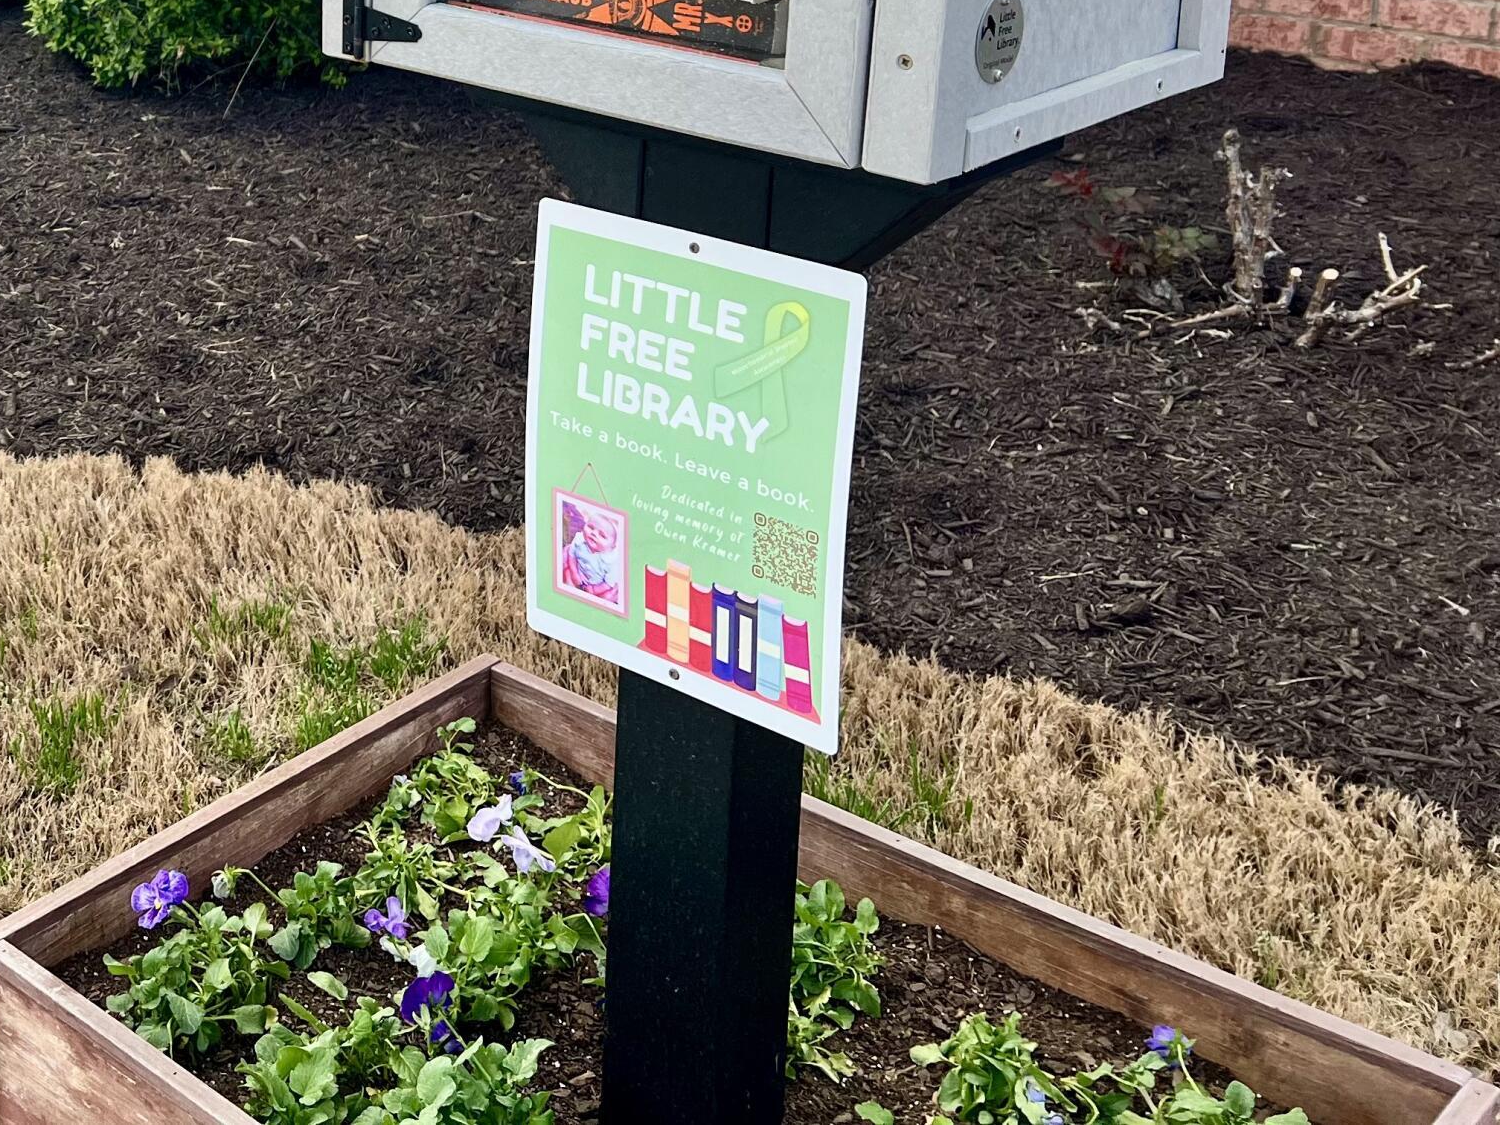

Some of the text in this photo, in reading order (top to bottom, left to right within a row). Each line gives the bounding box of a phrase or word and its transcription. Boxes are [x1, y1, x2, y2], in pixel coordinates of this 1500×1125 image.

[672, 0, 703, 32] MR.
[703, 12, 733, 28] X
[998, 25, 1012, 36] Free
[999, 9, 1016, 23] Little
[996, 36, 1019, 50] Library
[583, 263, 748, 344] LITTLE
[580, 313, 696, 381] FREE
[576, 361, 770, 455] LIBRARY
[550, 410, 815, 513] Take a book. Leave a book.
[632, 493, 746, 545] loving memory of
[660, 484, 743, 525] Dedicated in
[654, 521, 741, 563] Owen Kramer
